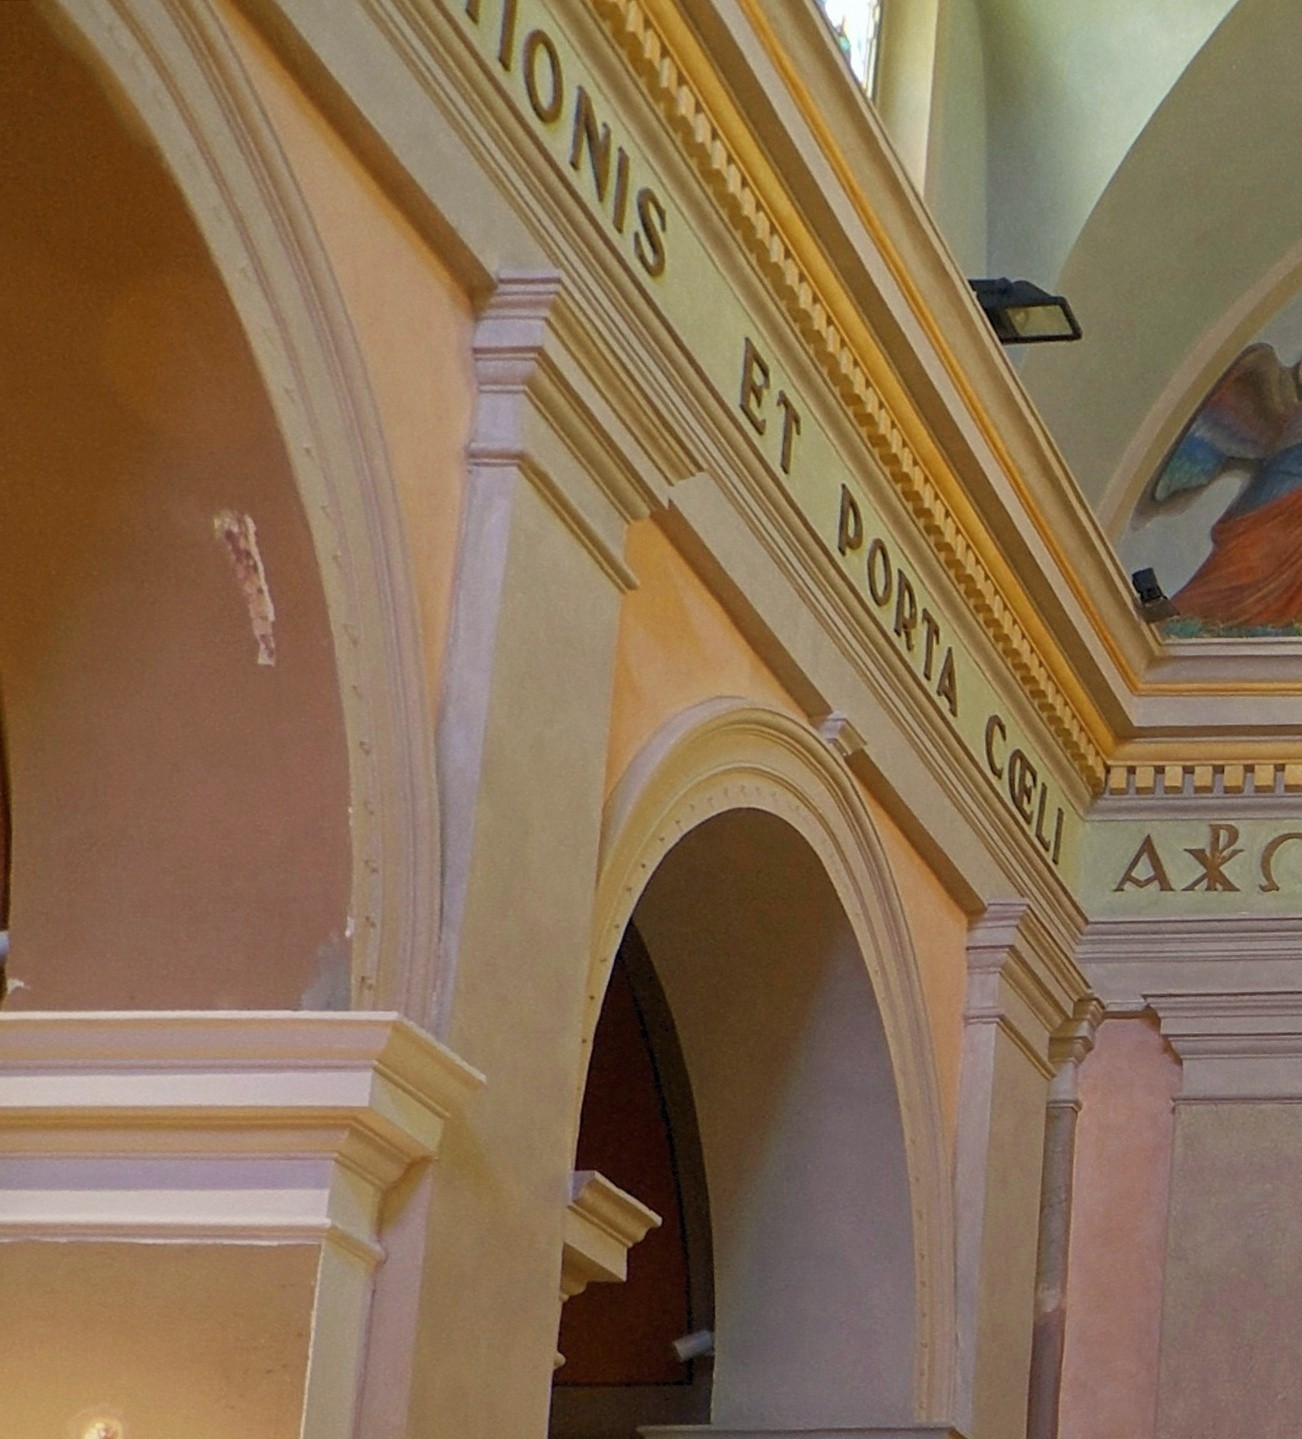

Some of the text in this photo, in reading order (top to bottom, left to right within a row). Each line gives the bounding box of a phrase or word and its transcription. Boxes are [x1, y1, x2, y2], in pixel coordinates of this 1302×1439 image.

[465, 0, 666, 278] IONIS
[739, 336, 801, 475] ET
[838, 484, 959, 718] PORTA
